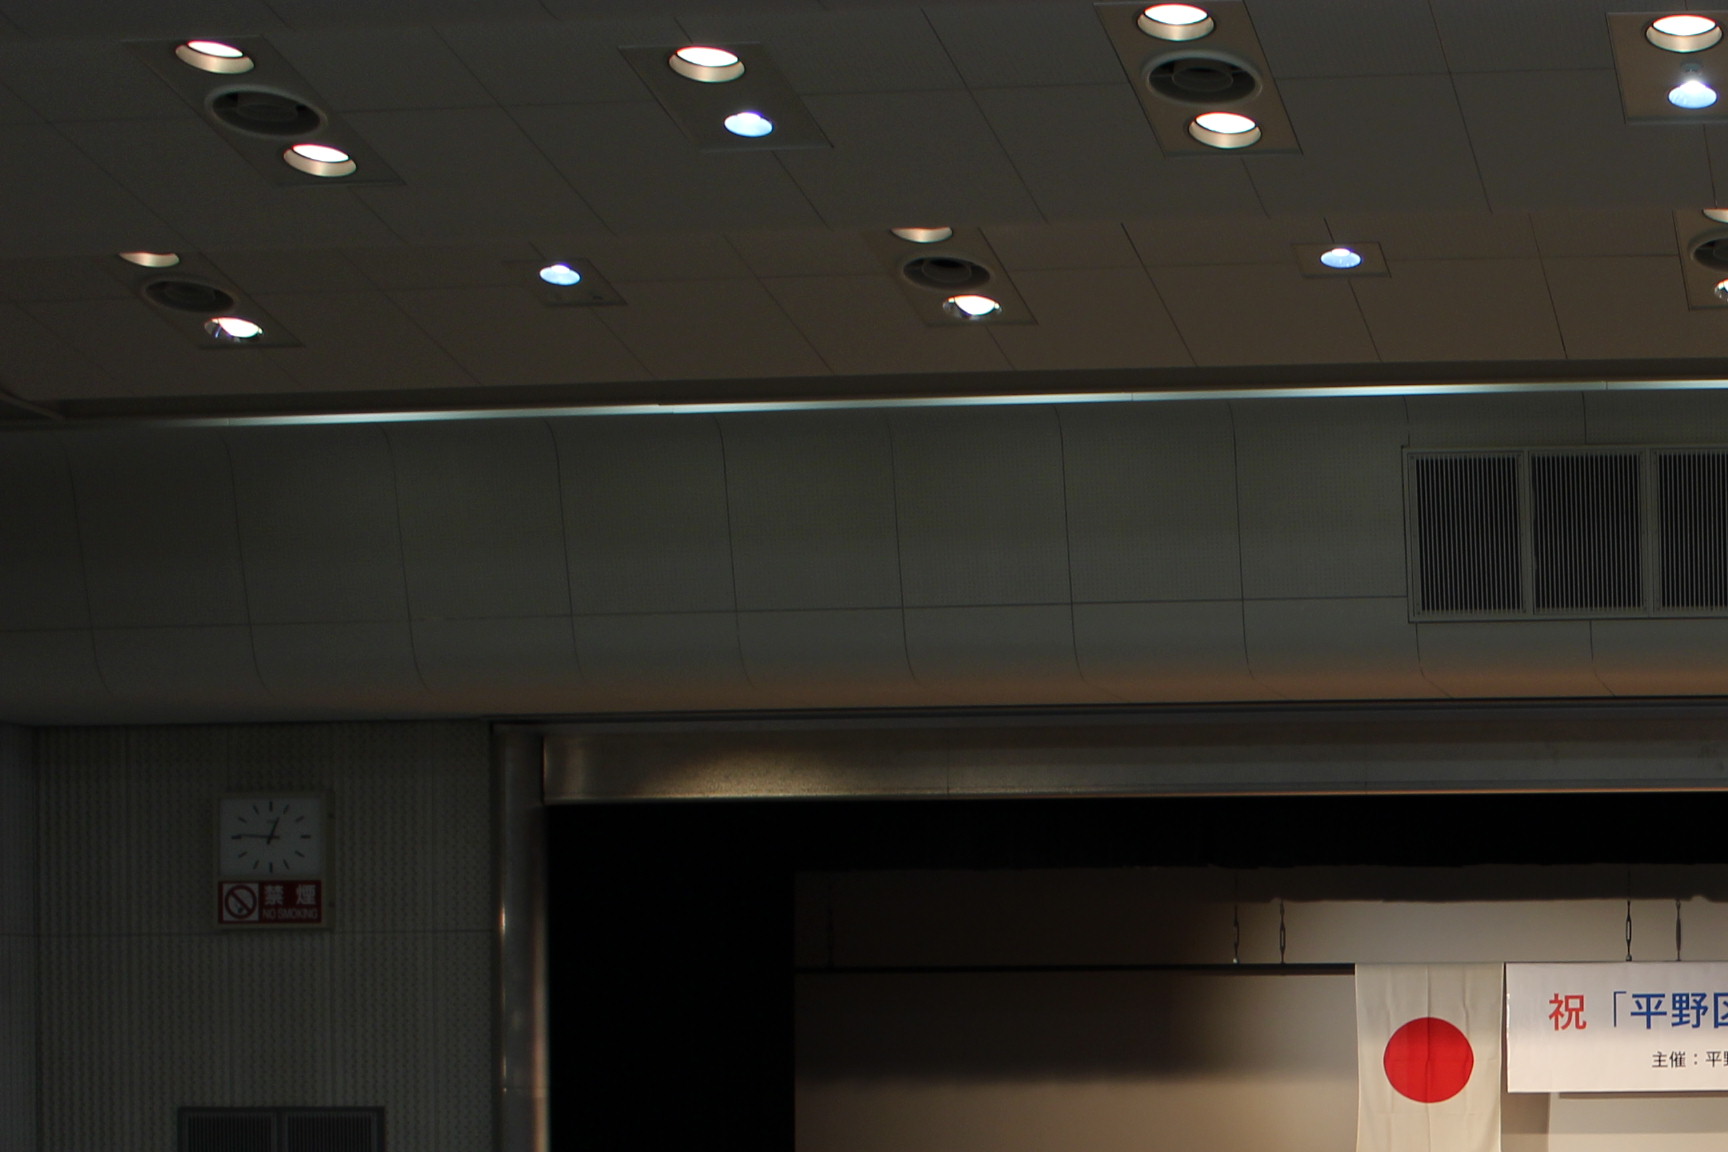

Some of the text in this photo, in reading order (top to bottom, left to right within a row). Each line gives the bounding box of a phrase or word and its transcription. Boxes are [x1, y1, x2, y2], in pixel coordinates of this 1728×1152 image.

[263, 884, 317, 906] 禁煙
[262, 908, 318, 920] NO SMOKING
[1549, 993, 1587, 1030] 祝
